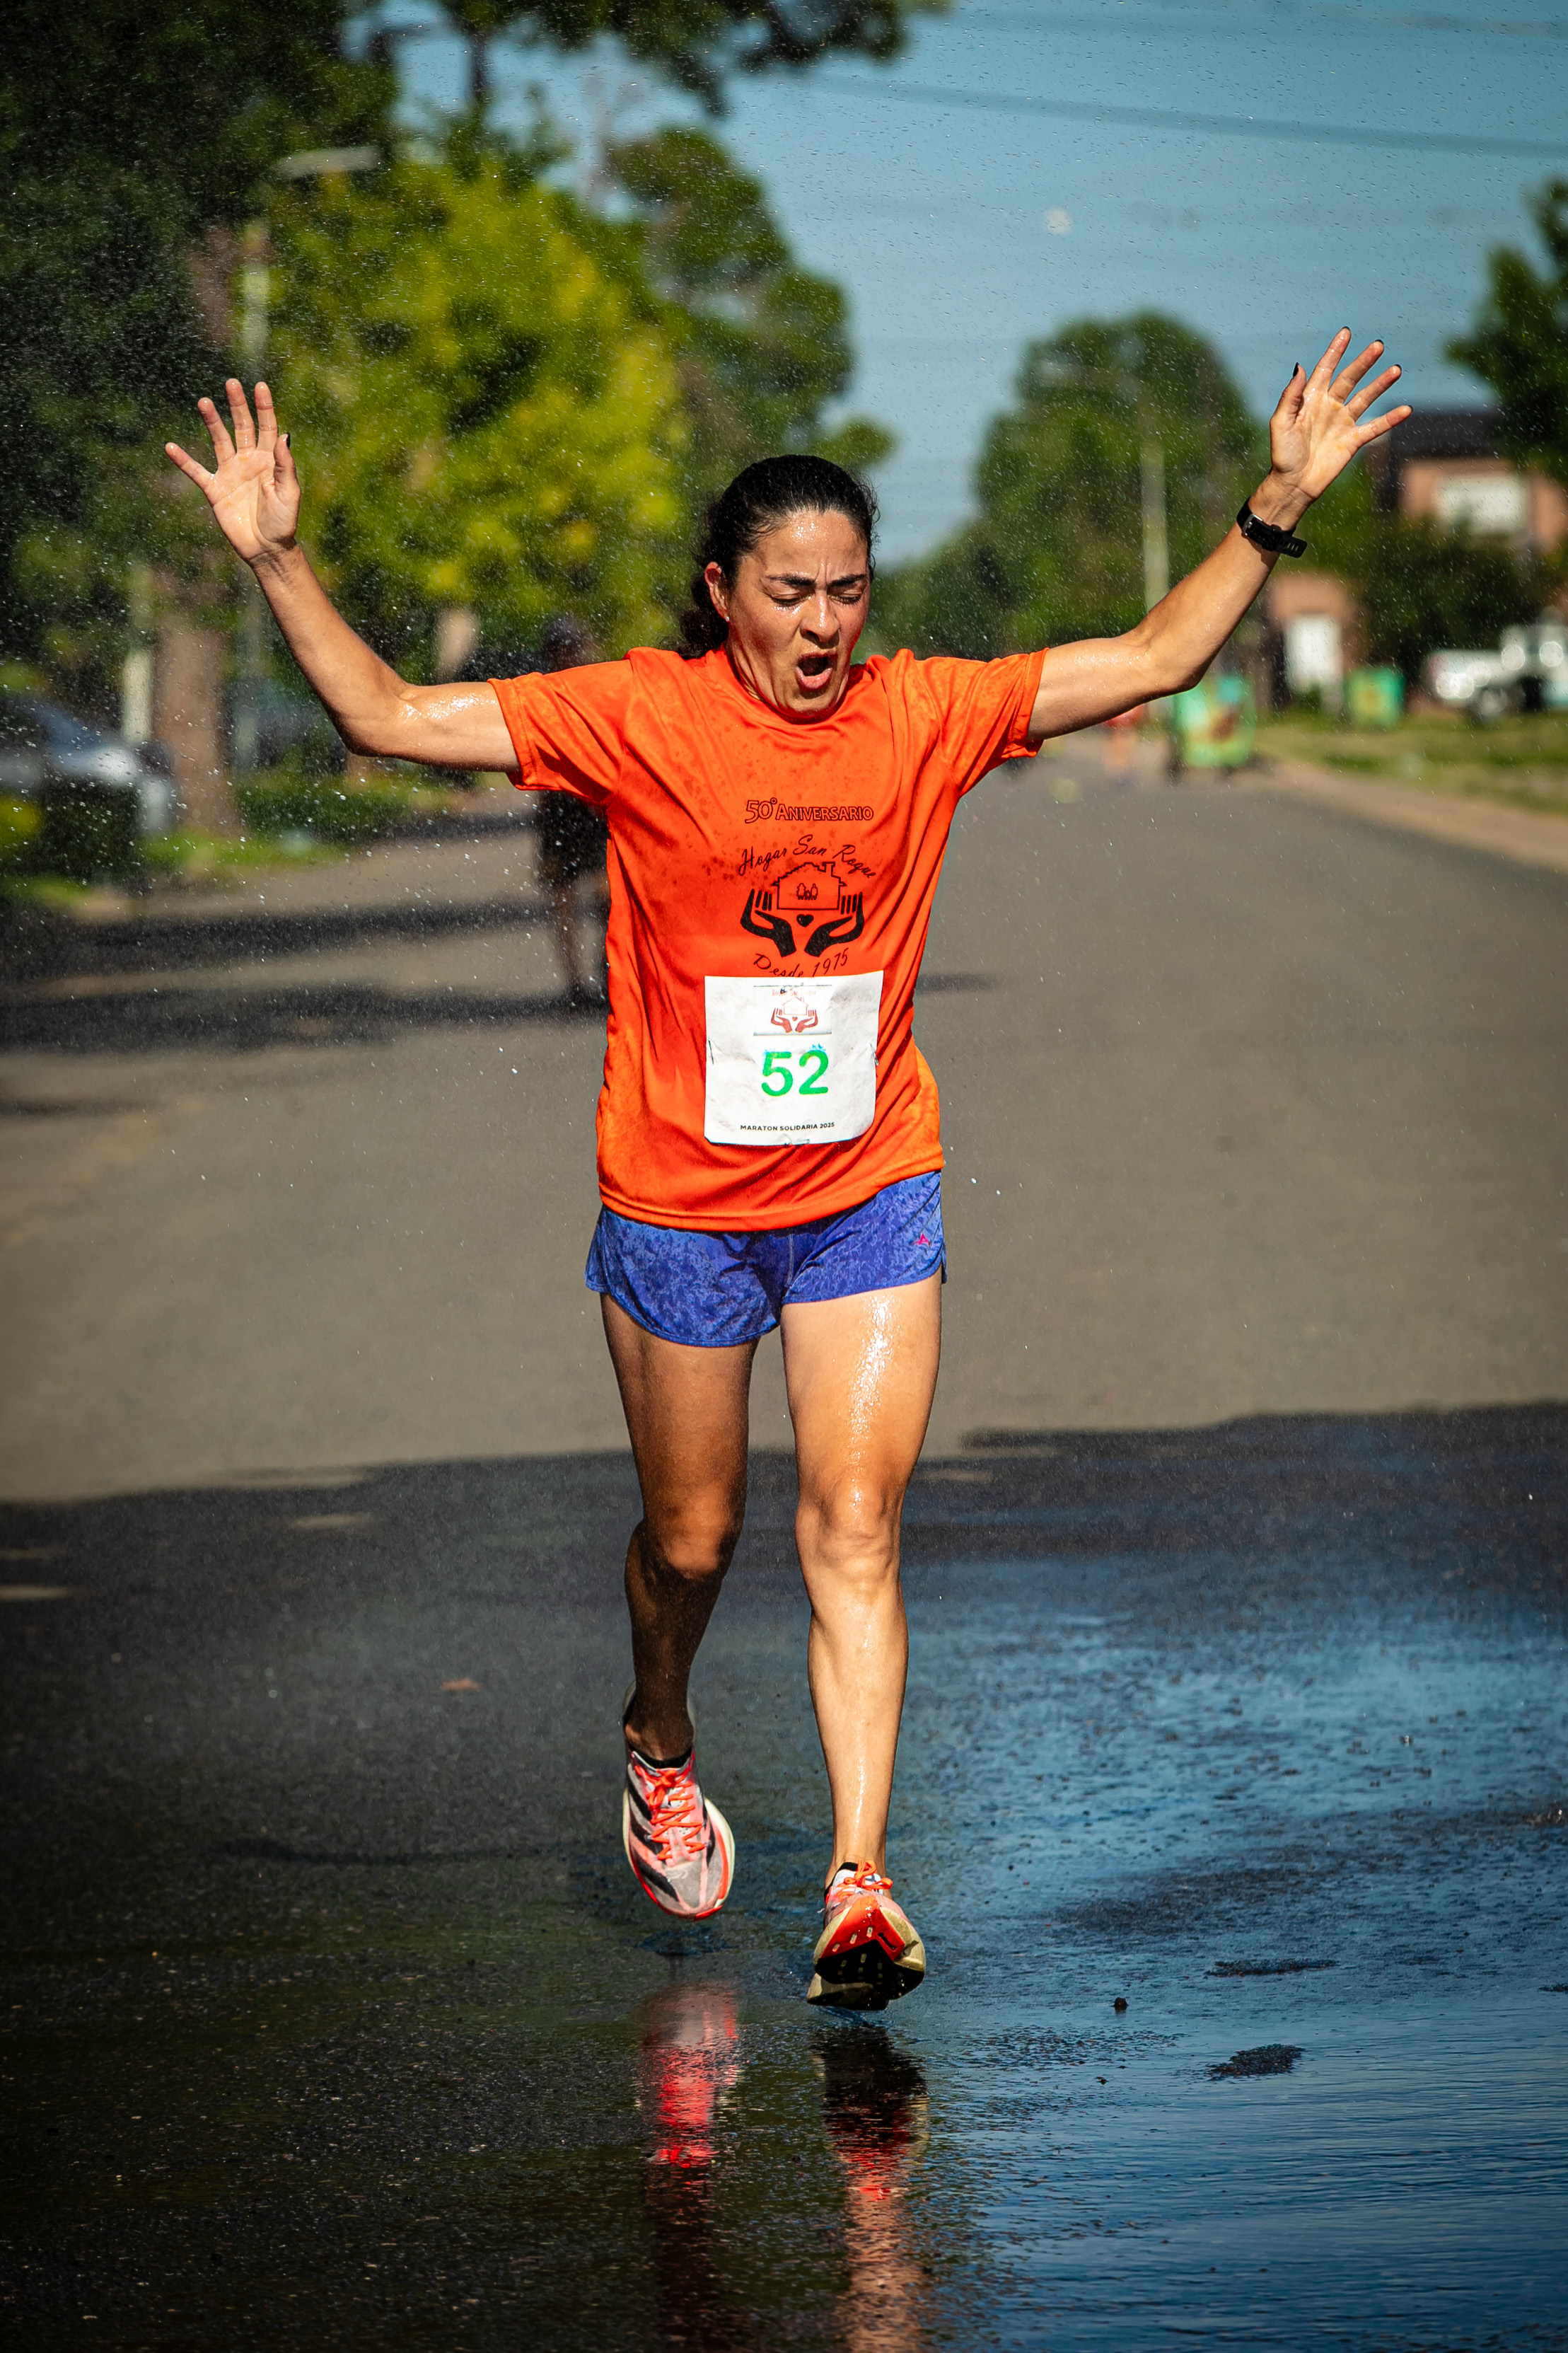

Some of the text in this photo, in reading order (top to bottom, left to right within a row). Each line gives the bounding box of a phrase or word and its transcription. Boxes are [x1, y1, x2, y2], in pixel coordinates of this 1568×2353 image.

[775, 804, 874, 821] ANIVERSARIO
[738, 846, 787, 876] Hogar
[793, 834, 827, 856] San
[753, 947, 849, 977] Desde 1975
[762, 1050, 829, 1097] 52
